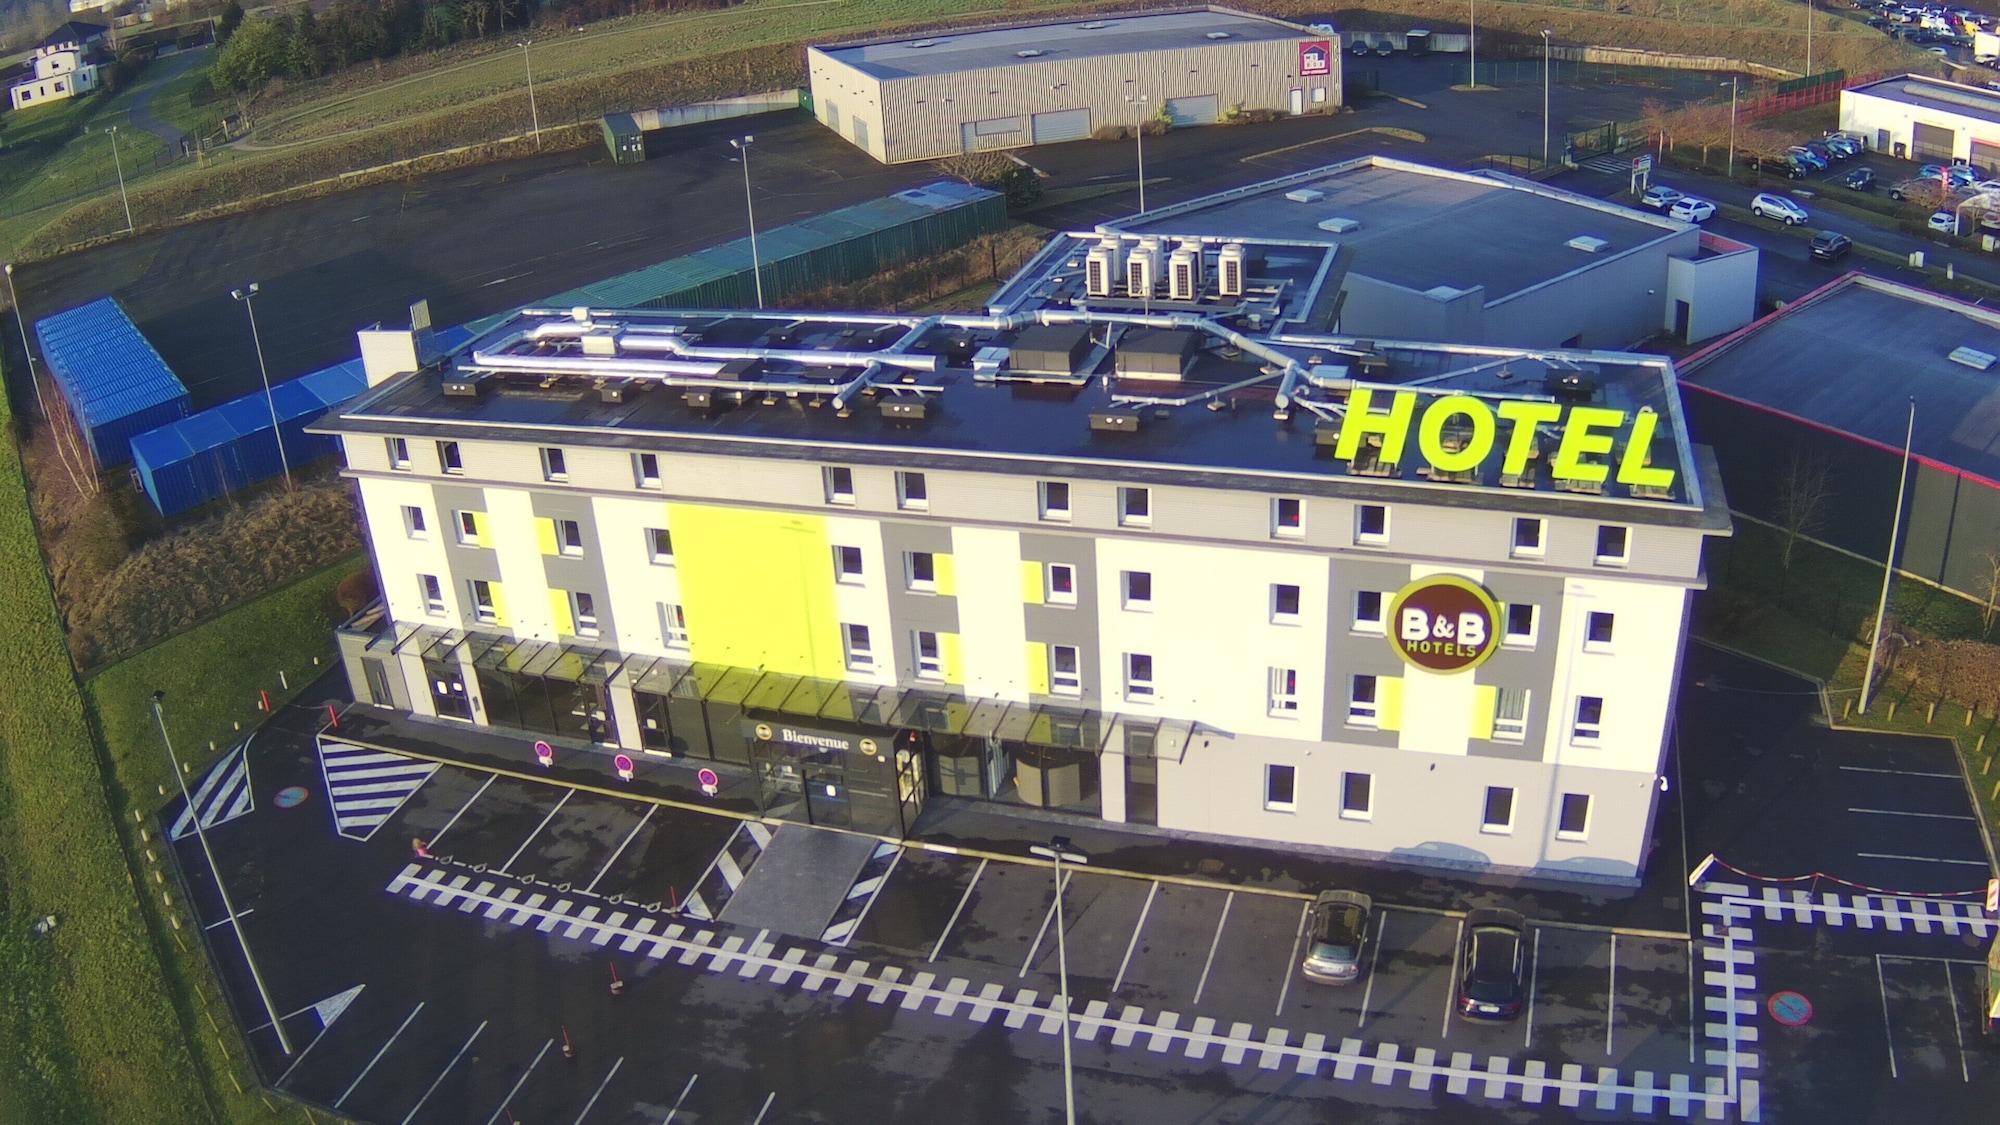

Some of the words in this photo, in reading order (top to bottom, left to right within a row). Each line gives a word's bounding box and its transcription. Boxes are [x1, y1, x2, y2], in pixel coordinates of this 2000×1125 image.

[1334, 388, 1675, 487] HOTEL
[1402, 608, 1485, 645] B&B
[1407, 640, 1477, 658] HOTELS
[783, 729, 850, 750] Bienvenue
